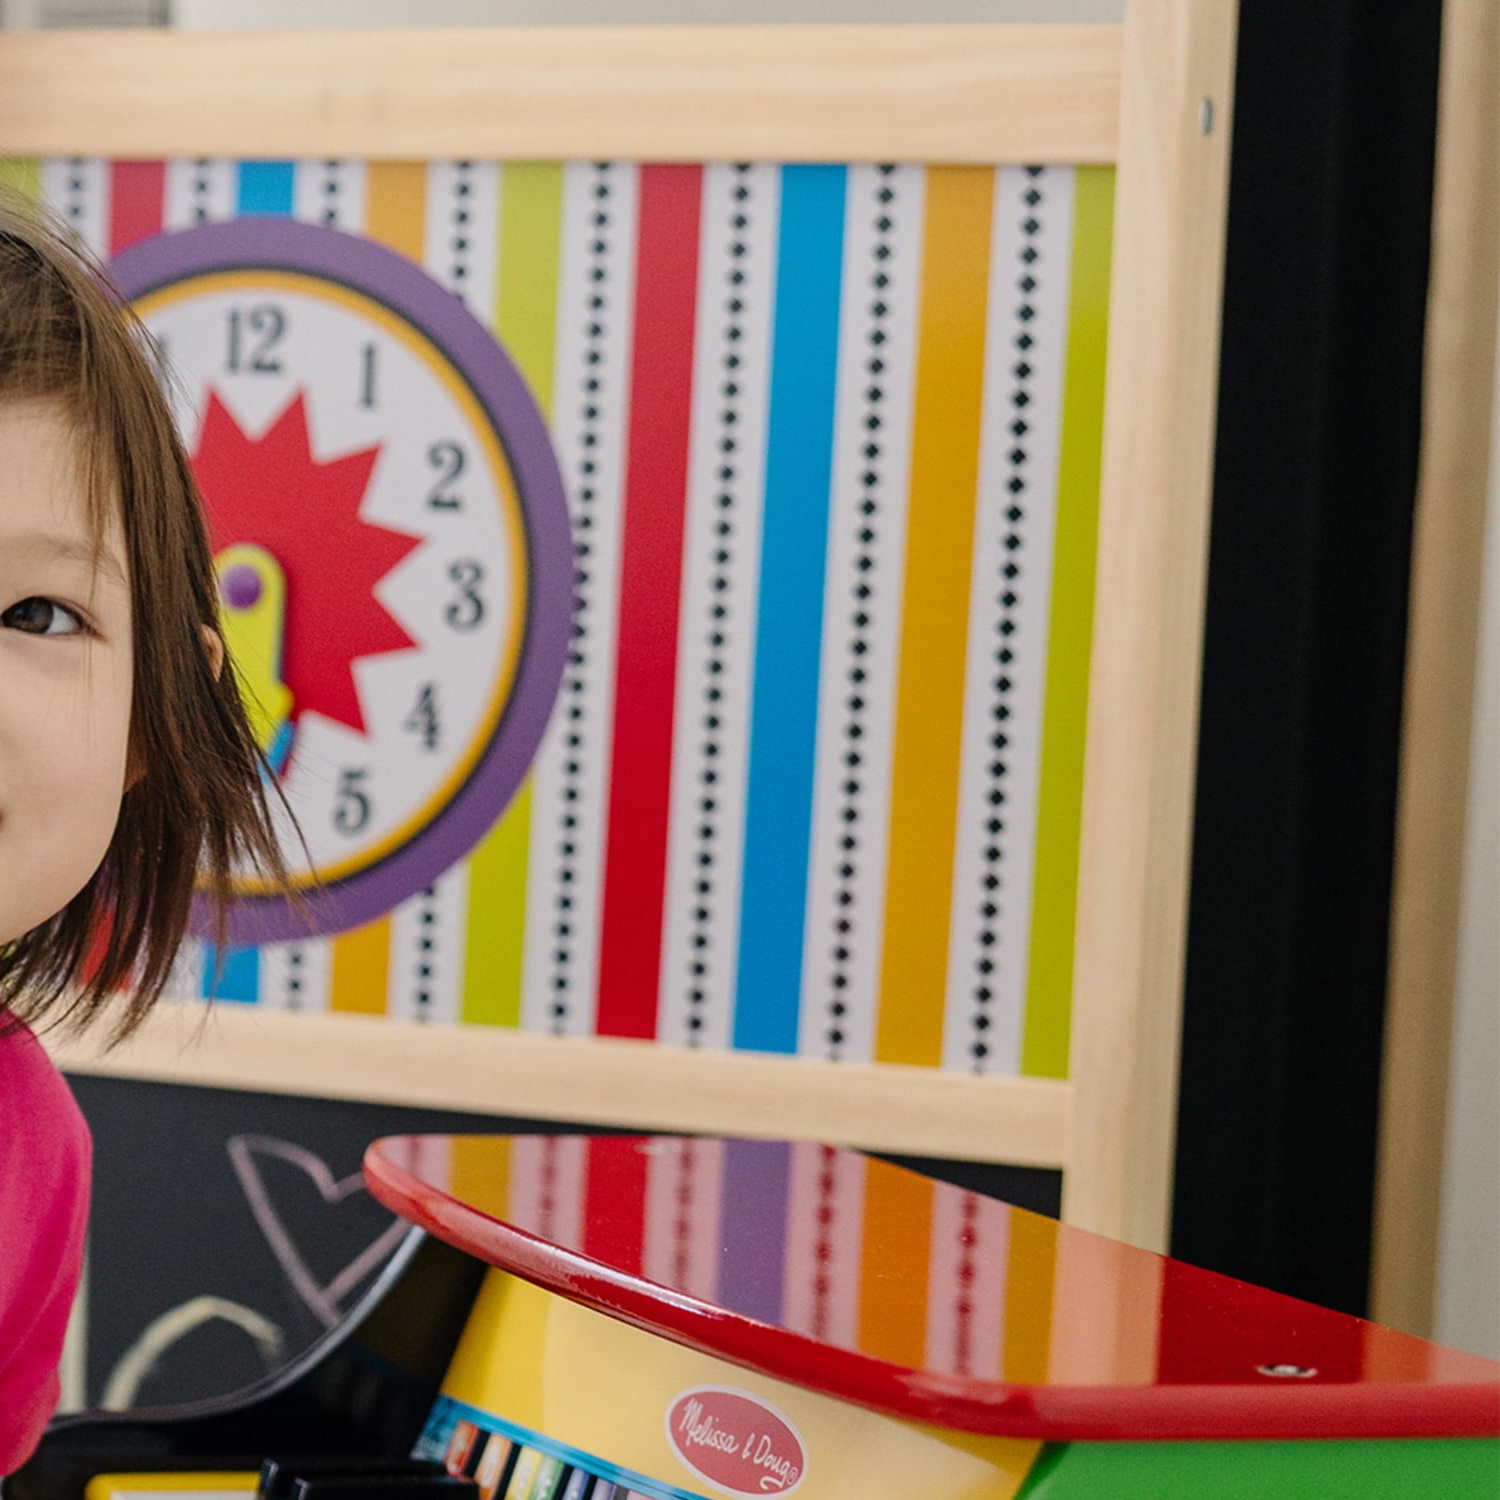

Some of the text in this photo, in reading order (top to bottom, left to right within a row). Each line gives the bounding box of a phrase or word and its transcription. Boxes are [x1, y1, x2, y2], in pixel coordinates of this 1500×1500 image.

[227, 303, 286, 374] 12
[361, 342, 377, 409] 1
[426, 440, 466, 511] 2
[445, 559, 485, 631] 3
[404, 682, 438, 752] 4
[334, 767, 371, 836] 5
[678, 1397, 739, 1454] Melissa
